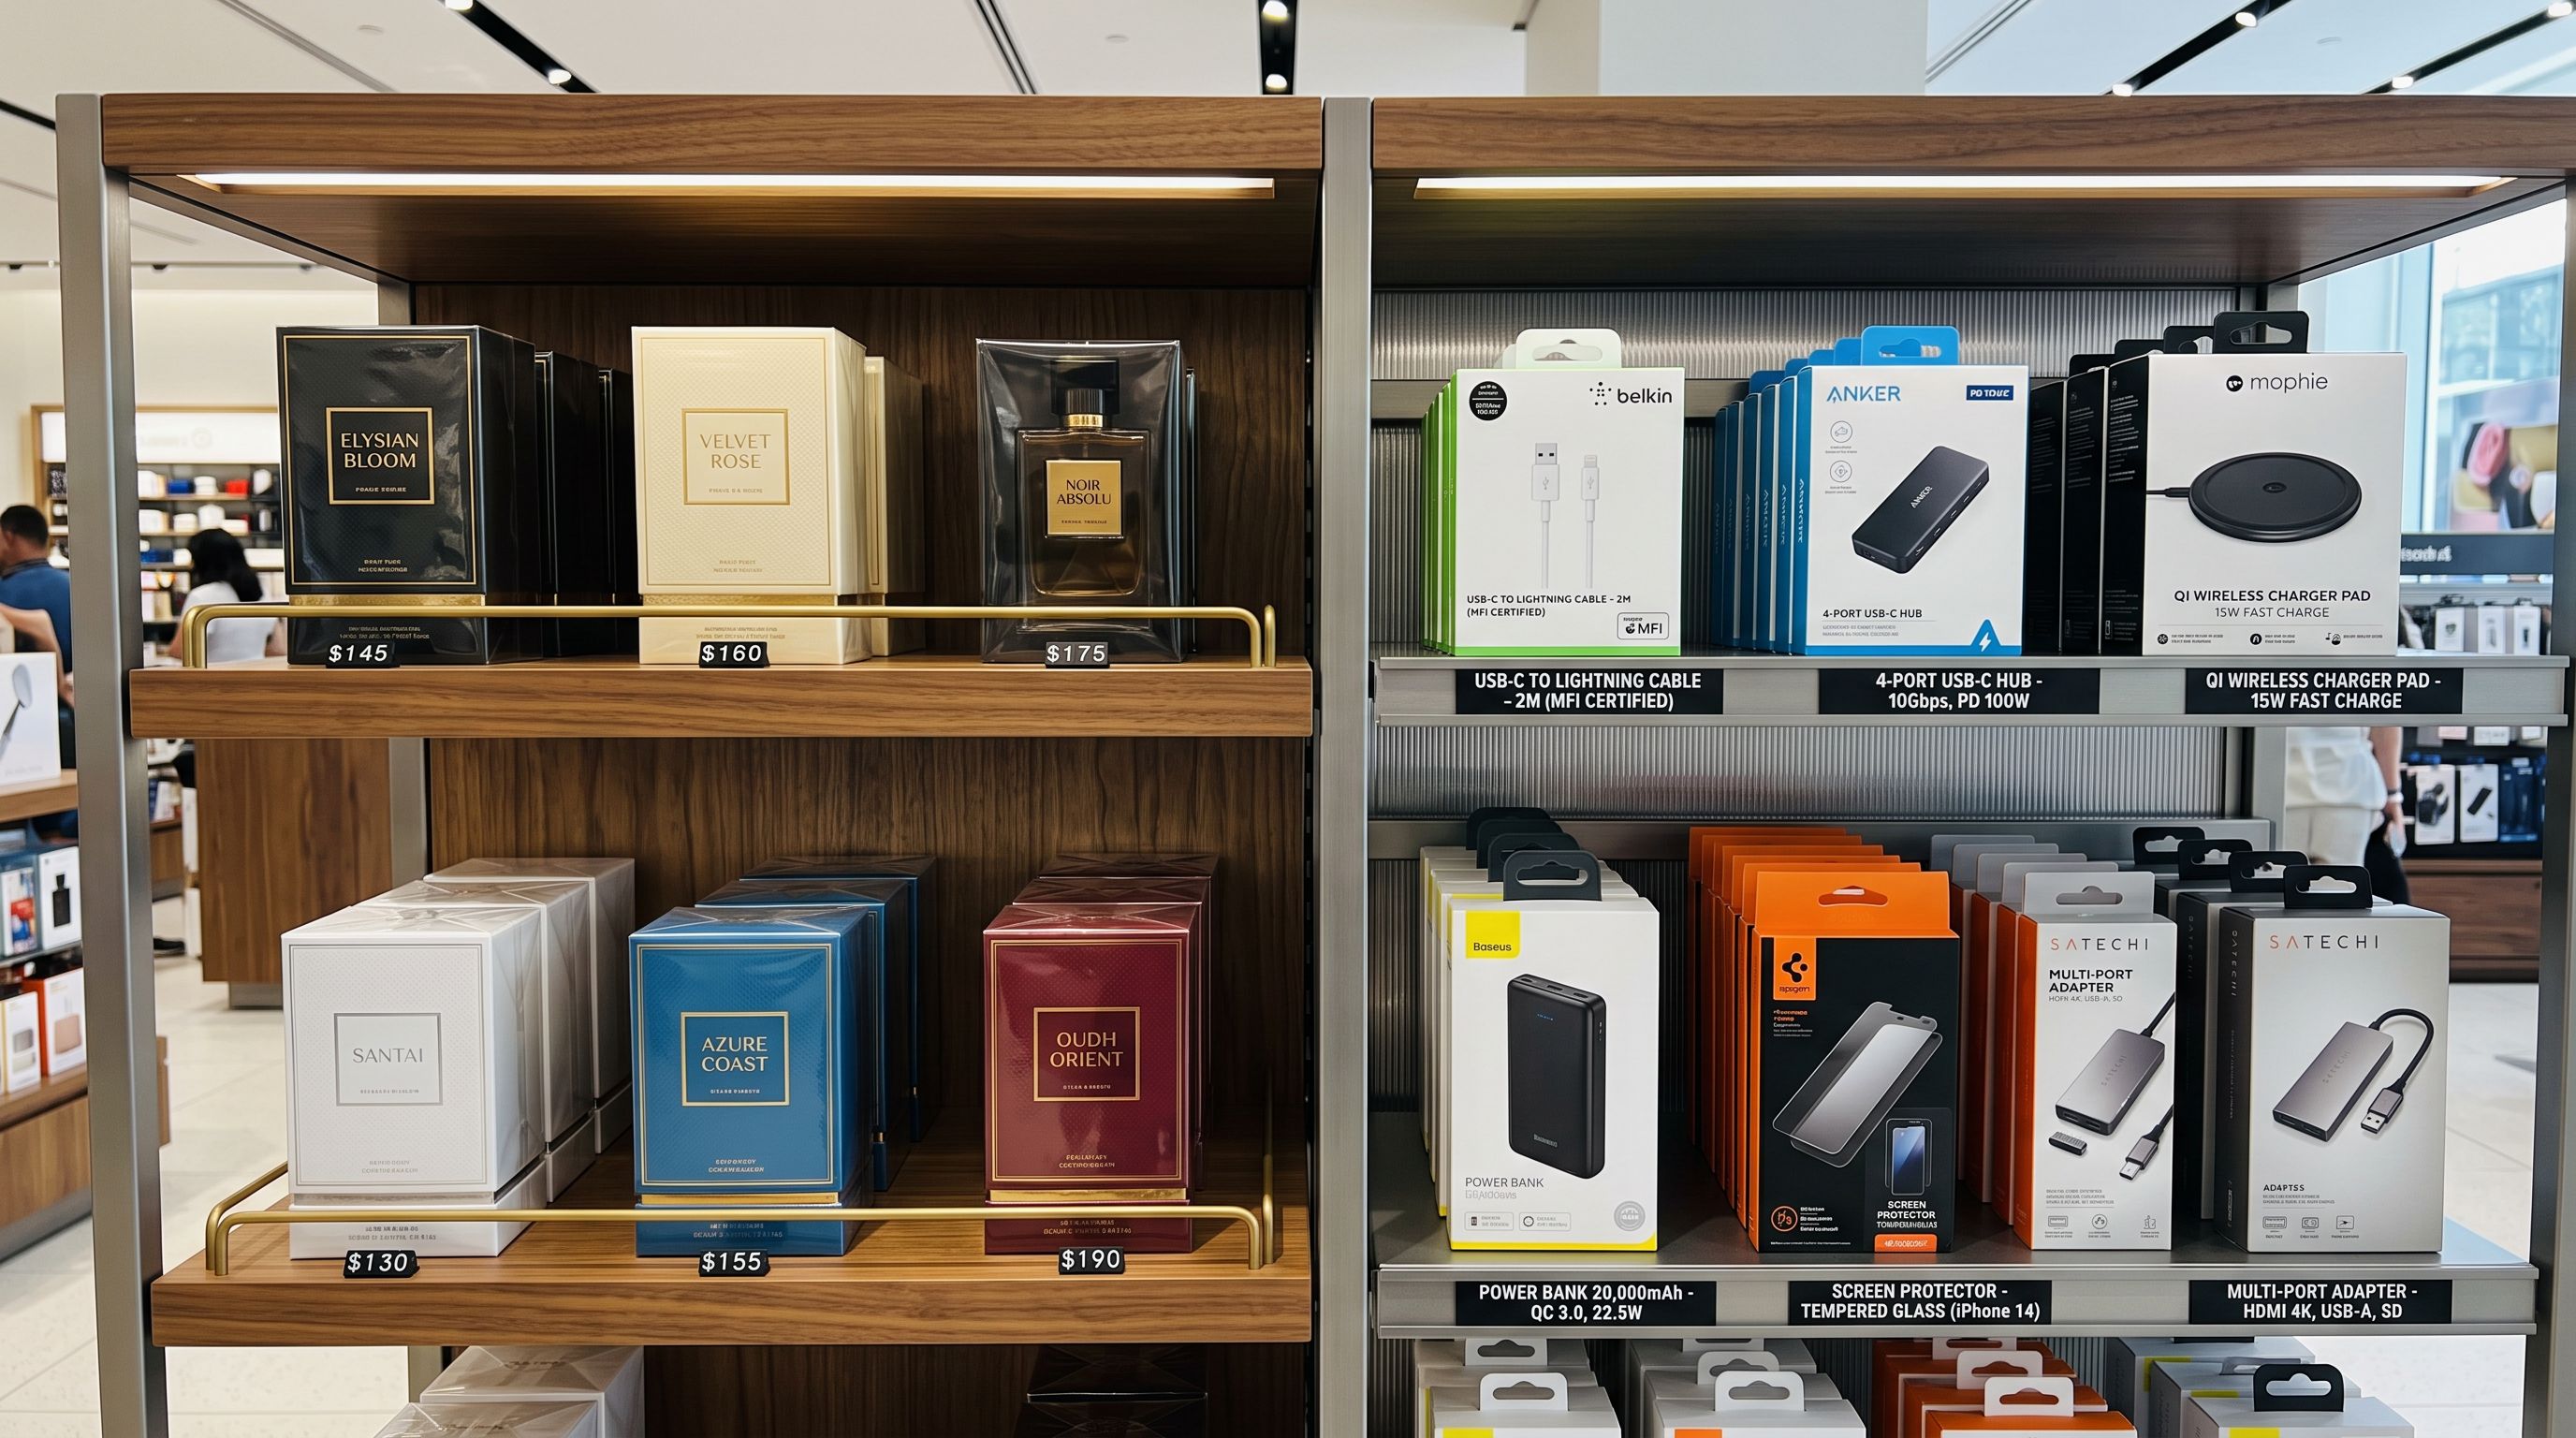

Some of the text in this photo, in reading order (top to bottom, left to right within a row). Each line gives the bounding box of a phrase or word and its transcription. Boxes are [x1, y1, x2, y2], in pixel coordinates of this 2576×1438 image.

[2250, 372, 2328, 394] mophie
[1617, 388, 1673, 404] belkin
[1826, 385, 1901, 404] ANKER
[341, 433, 418, 448] ELYSIAN
[699, 433, 771, 449] VELVET
[344, 452, 416, 468] BLOOM
[710, 453, 762, 469] ROSE
[1066, 478, 1101, 492] NOIR
[1056, 492, 1111, 506] ABSOLU
[1467, 594, 1499, 604] USB-C
[1500, 594, 1515, 604] TO
[1516, 594, 1573, 604] LIGHTNING
[1574, 594, 1607, 604] CABLE
[1617, 594, 1632, 604] 2M
[2174, 590, 2371, 603] QI WIRELESS CHARGER PAD
[1467, 607, 1545, 618] (MFI CERTIFIED)
[1822, 609, 1923, 619] 4-PORT USB-C HUB
[2215, 607, 2330, 618] 15W FAST CHARGE
[1637, 623, 1662, 635] MFI
[329, 644, 388, 663] $145
[701, 644, 762, 663] $160
[1046, 644, 1105, 663] $175
[1474, 672, 1702, 689] USB-C TO LIGHTNING CABLE
[1875, 672, 1938, 689] 4-PORT
[1941, 672, 1992, 689] USB-C
[1997, 672, 2032, 689] HUB
[2205, 671, 2223, 689] QI
[2227, 671, 2309, 689] WIRELESS
[2313, 671, 2393, 689] CHARGER
[2396, 672, 2430, 688] PAD
[1515, 692, 1541, 709] 2M
[1544, 692, 1580, 712] (MFI
[1585, 692, 1674, 712] CERTIFIED)
[1888, 692, 2030, 712] 10Gbps, PD 100W
[2250, 692, 2403, 709] 15W FAST CHARGE
[1473, 942, 1514, 952] Baseus
[2051, 938, 2148, 951] SATECHI
[2270, 934, 2378, 949] SATECHI
[2049, 969, 2133, 980] MULTI-PORT
[2048, 982, 2114, 993] ADAPTER
[701, 1036, 768, 1052] AZURE
[1056, 1032, 1116, 1048] OUDH
[701, 1056, 768, 1072] COAST
[1049, 1051, 1124, 1068] ORIENT
[1465, 1177, 1544, 1188] POWER BANK
[1887, 1200, 1926, 1210] SCREEN
[1877, 1211, 1936, 1219] PROTECTOR
[347, 1252, 408, 1272] $130
[701, 1251, 761, 1273] $155
[1061, 1248, 1120, 1270] $190
[1479, 1284, 1538, 1300] POWER
[1543, 1284, 1588, 1300] BANK
[1592, 1284, 1683, 1303] 20,000mAh
[1832, 1283, 1895, 1299] SCREEN
[1900, 1283, 1998, 1299] PROTECTOR
[2227, 1284, 2328, 1299] MULTI-PORT
[2331, 1284, 2407, 1299] ADAPTER
[1530, 1304, 1643, 1324] QC 3.0, 22.5W
[1800, 1301, 2041, 1323] TEMPERED GLASS (iPhone 14)
[2244, 1302, 2403, 1322] HDMI 4K, USB-A, SD
